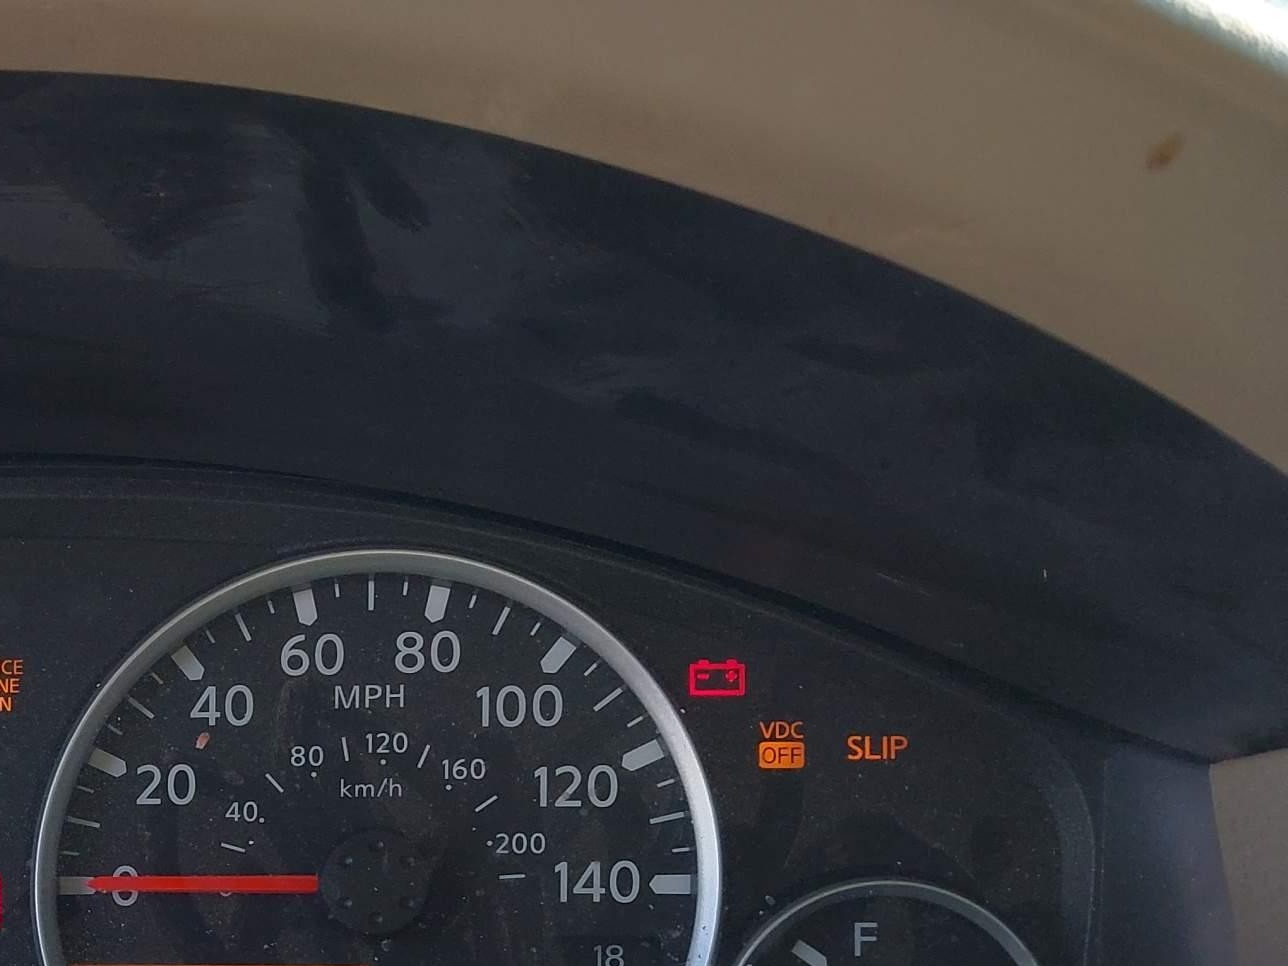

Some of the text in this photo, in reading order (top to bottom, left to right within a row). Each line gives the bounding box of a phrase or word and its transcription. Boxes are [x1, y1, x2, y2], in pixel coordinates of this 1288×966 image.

[280, 633, 345, 676] 60
[394, 631, 461, 674] 80
[190, 684, 253, 727] 40
[333, 685, 405, 709] MPH
[475, 685, 563, 728] 100
[364, 732, 408, 754] 120
[759, 721, 804, 740] VDC
[290, 745, 324, 768] 80
[761, 746, 803, 765] OFF
[847, 735, 908, 762] SLIP
[441, 758, 486, 781] 160
[135, 764, 195, 806] 20
[339, 777, 403, 799] km/h
[534, 764, 618, 808] 120
[225, 801, 258, 823] 40
[495, 832, 546, 854] 200
[553, 860, 640, 903] 140
[854, 922, 878, 957] F
